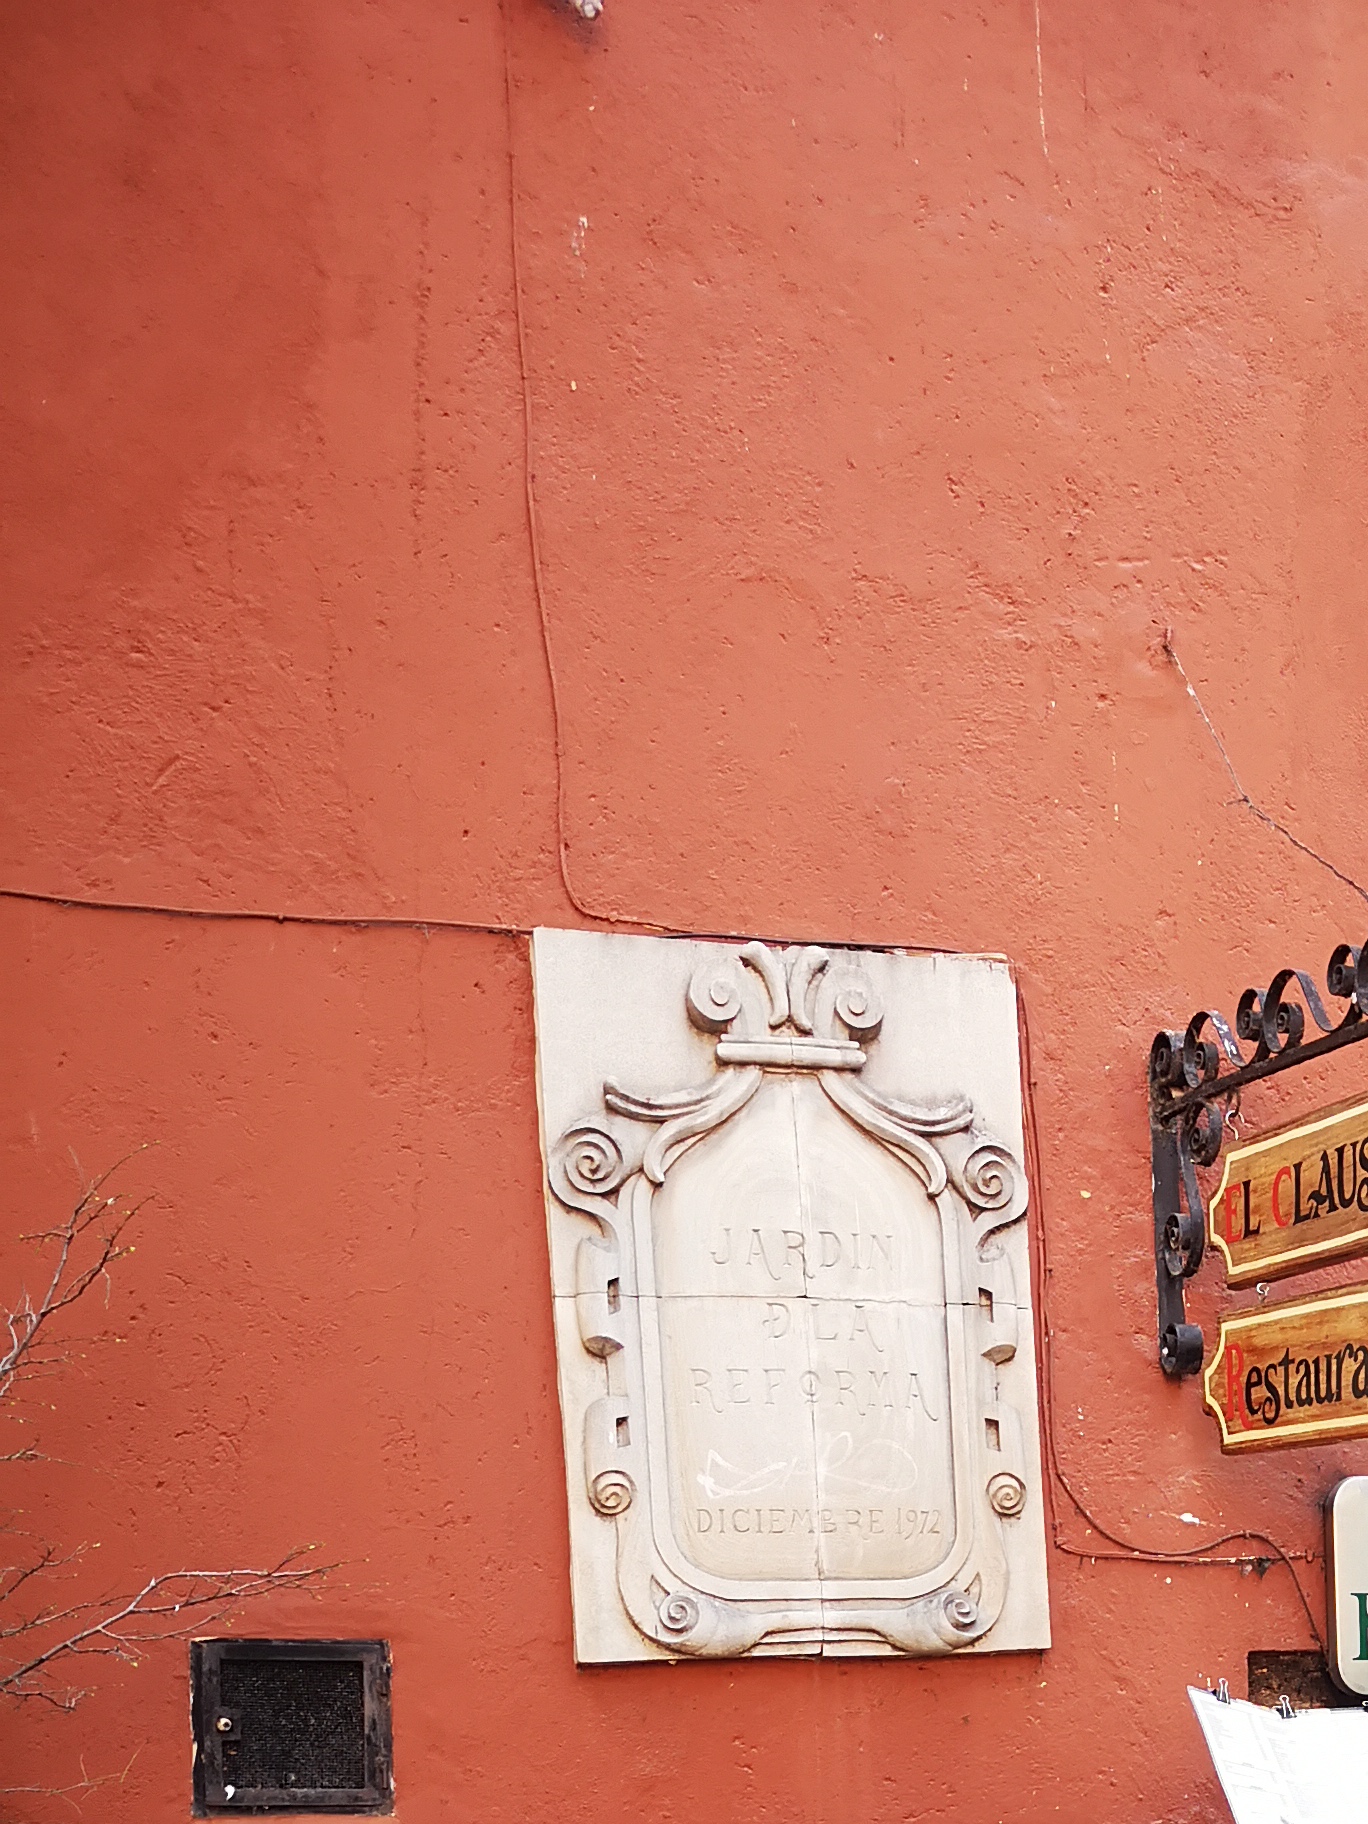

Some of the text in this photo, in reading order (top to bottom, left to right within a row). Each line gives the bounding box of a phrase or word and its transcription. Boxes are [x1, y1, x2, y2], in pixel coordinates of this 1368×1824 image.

[1223, 1179, 1260, 1245] EL
[710, 1228, 895, 1280] JARDIN
[689, 1368, 939, 1422] REFORMA
[696, 1507, 942, 1541] DICIEMBRE 1972
